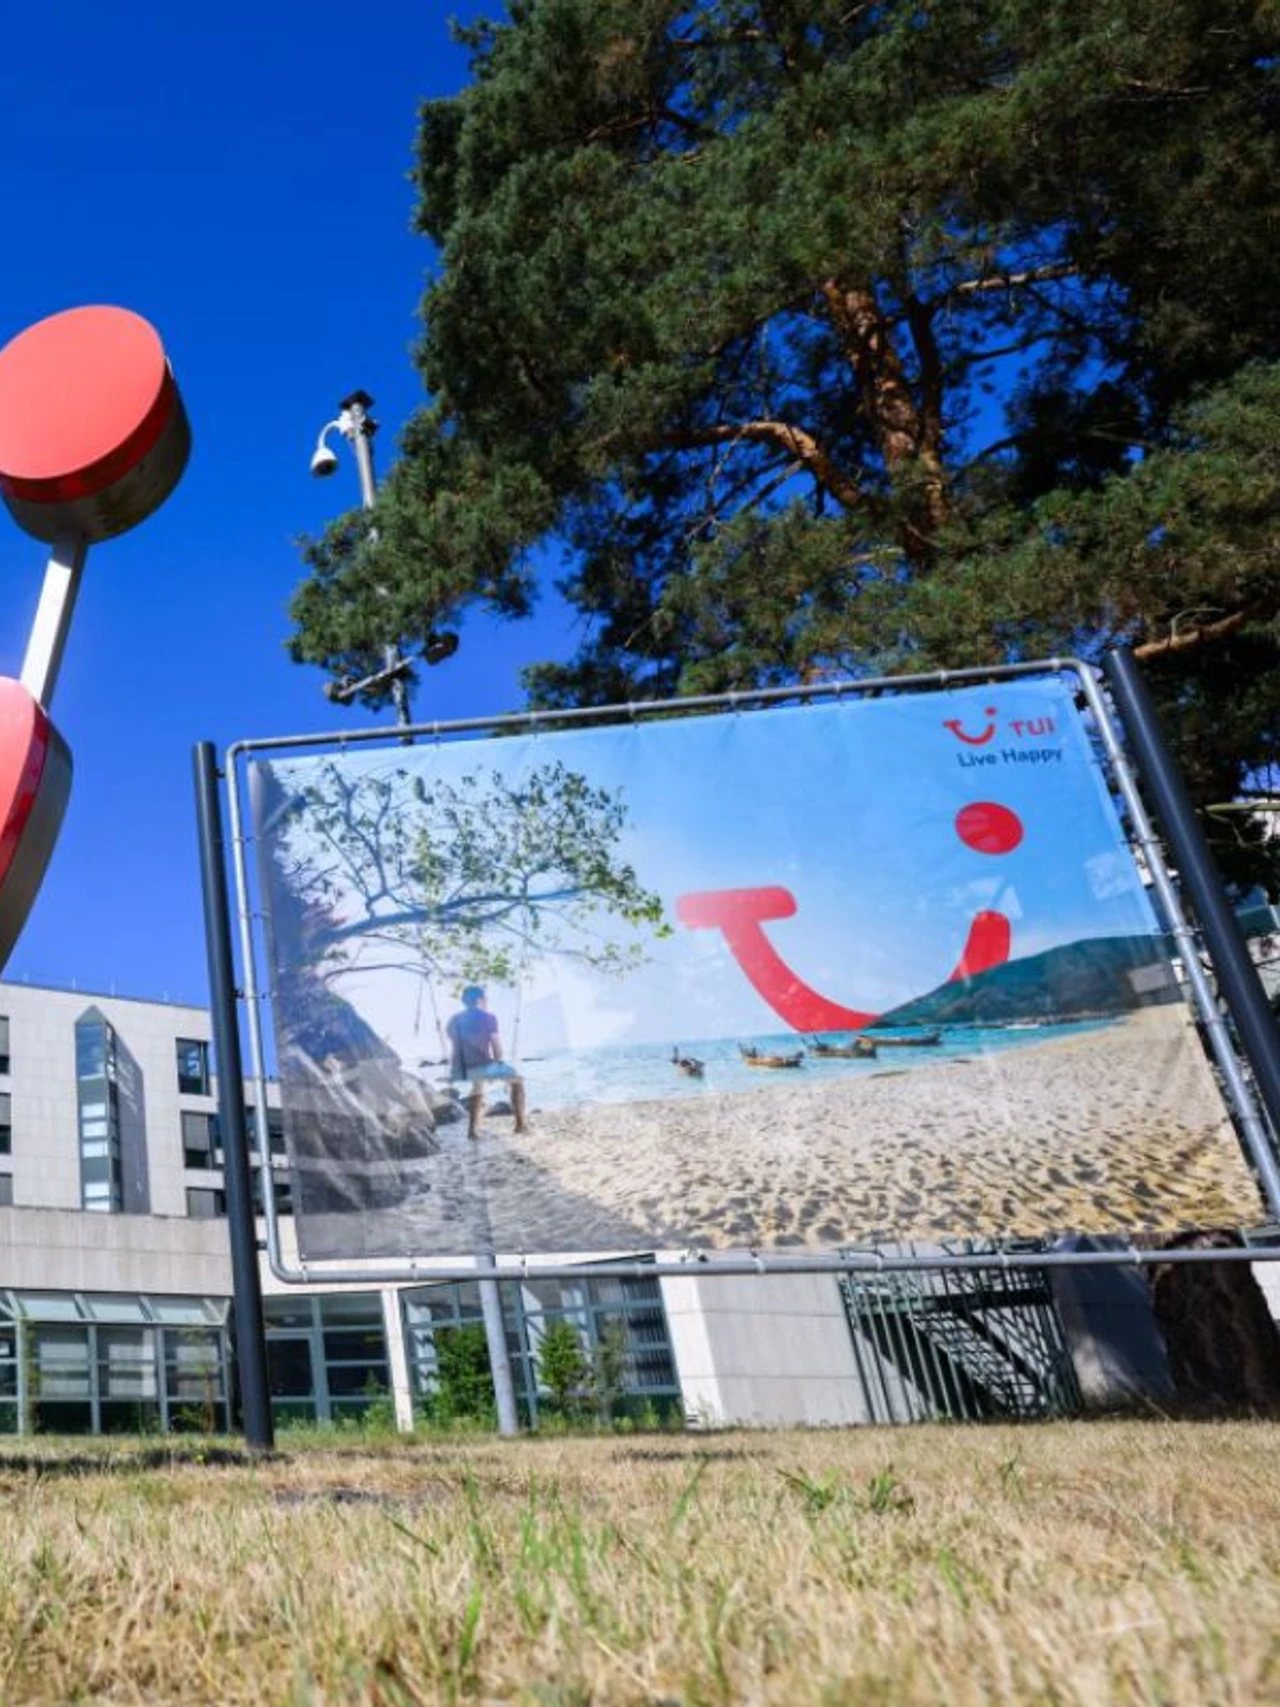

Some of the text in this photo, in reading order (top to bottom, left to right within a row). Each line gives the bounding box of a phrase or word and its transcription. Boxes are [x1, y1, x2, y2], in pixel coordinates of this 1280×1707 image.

[1009, 716, 1054, 737] TUI
[956, 748, 1062, 768] Live Happy
